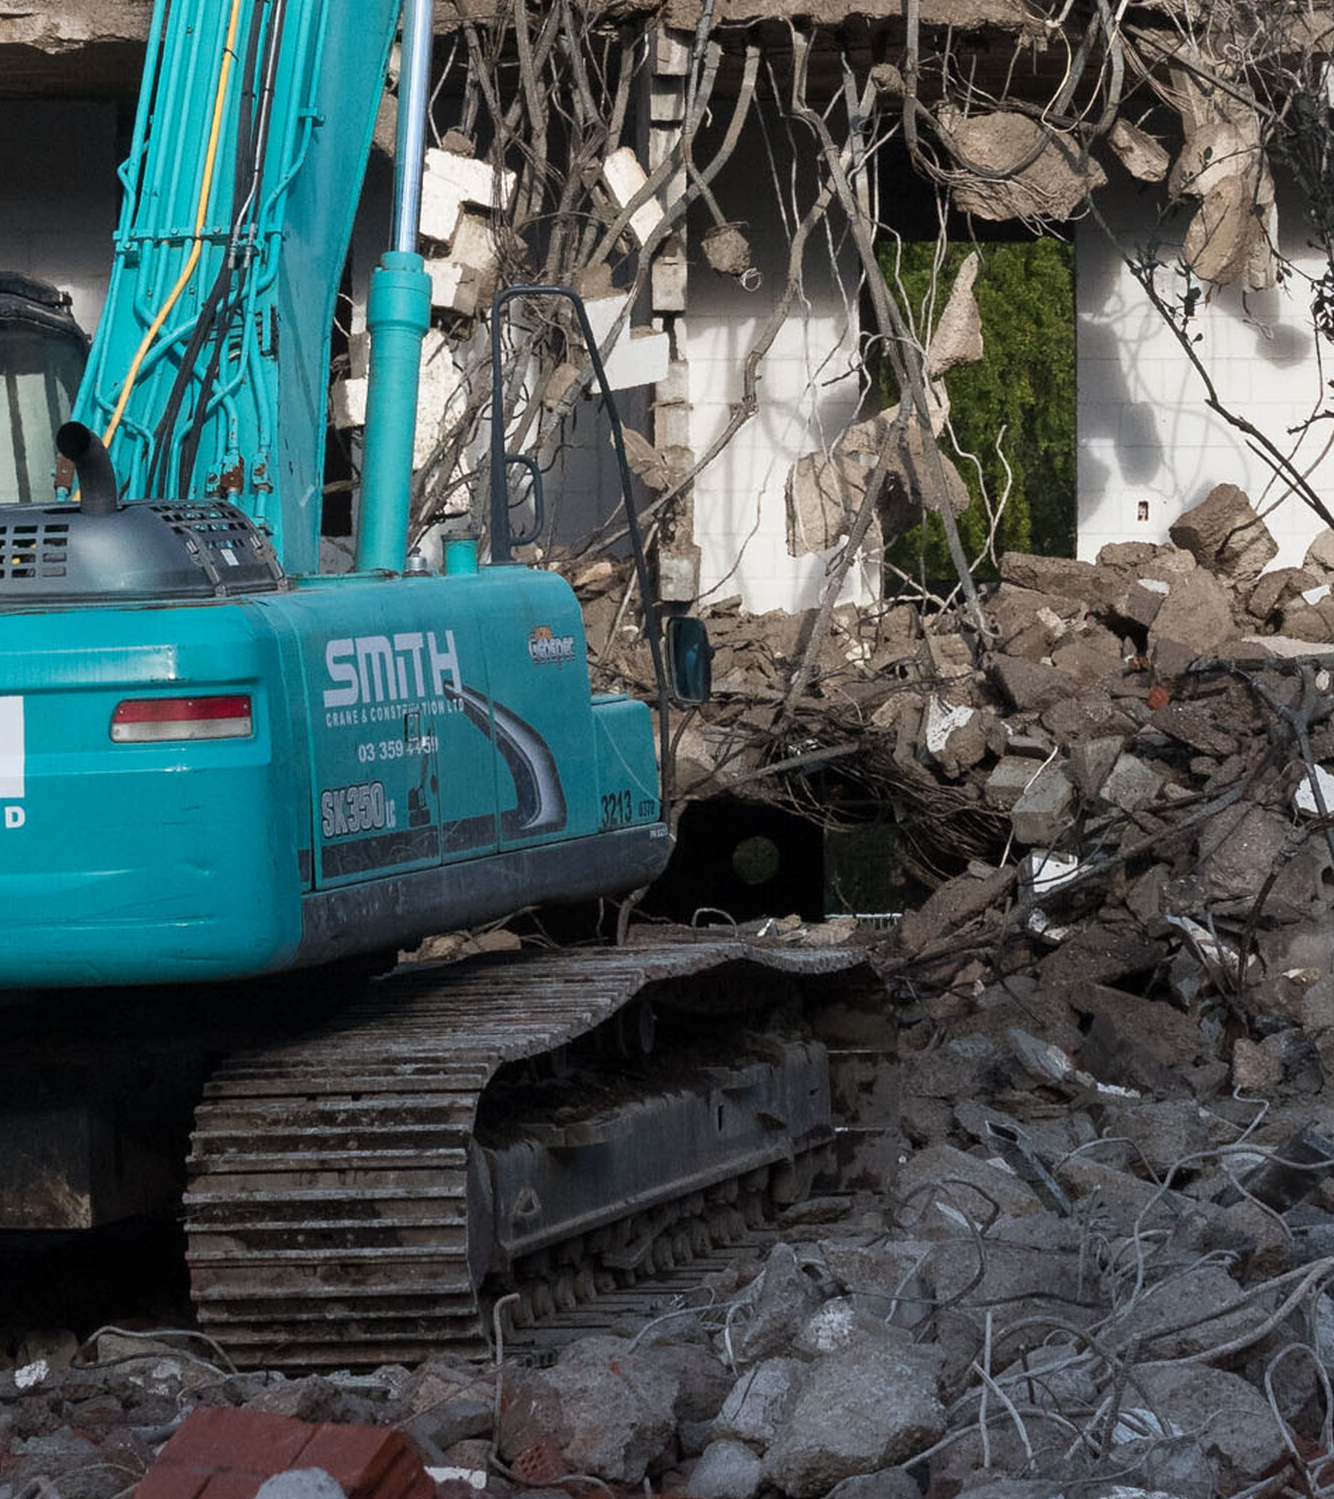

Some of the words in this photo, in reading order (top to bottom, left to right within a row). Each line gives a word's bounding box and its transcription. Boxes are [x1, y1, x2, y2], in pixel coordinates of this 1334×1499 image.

[323, 630, 464, 708] SMITH
[326, 709, 359, 728] CRANE
[361, 708, 368, 723] &
[447, 698, 465, 712] LTD
[358, 743, 376, 763] 03
[379, 739, 404, 760] 359
